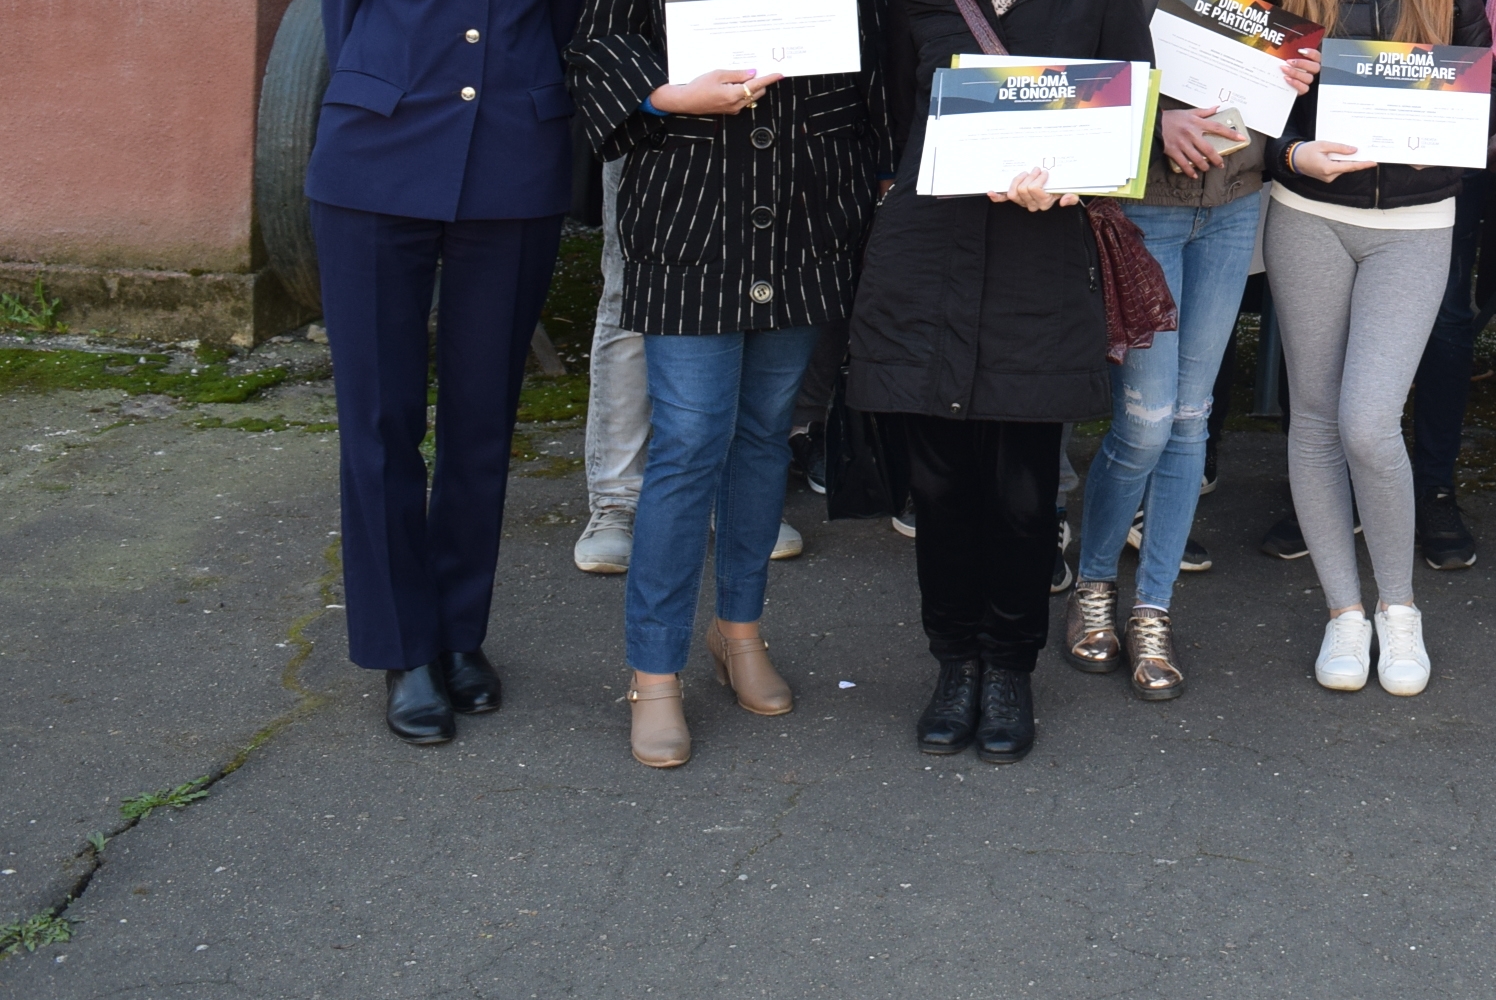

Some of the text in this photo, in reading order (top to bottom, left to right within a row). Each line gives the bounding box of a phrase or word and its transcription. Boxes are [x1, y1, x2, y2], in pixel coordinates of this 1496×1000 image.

[1194, 0, 1210, 16] DE
[1211, 5, 1285, 46] PARTICIPARE
[1379, 51, 1434, 66] DIPLOMĂ
[1356, 62, 1456, 80] DE PARTICIPARE
[1007, 72, 1068, 88] DIPLOMĂ
[999, 85, 1076, 100] DE ONOARE
